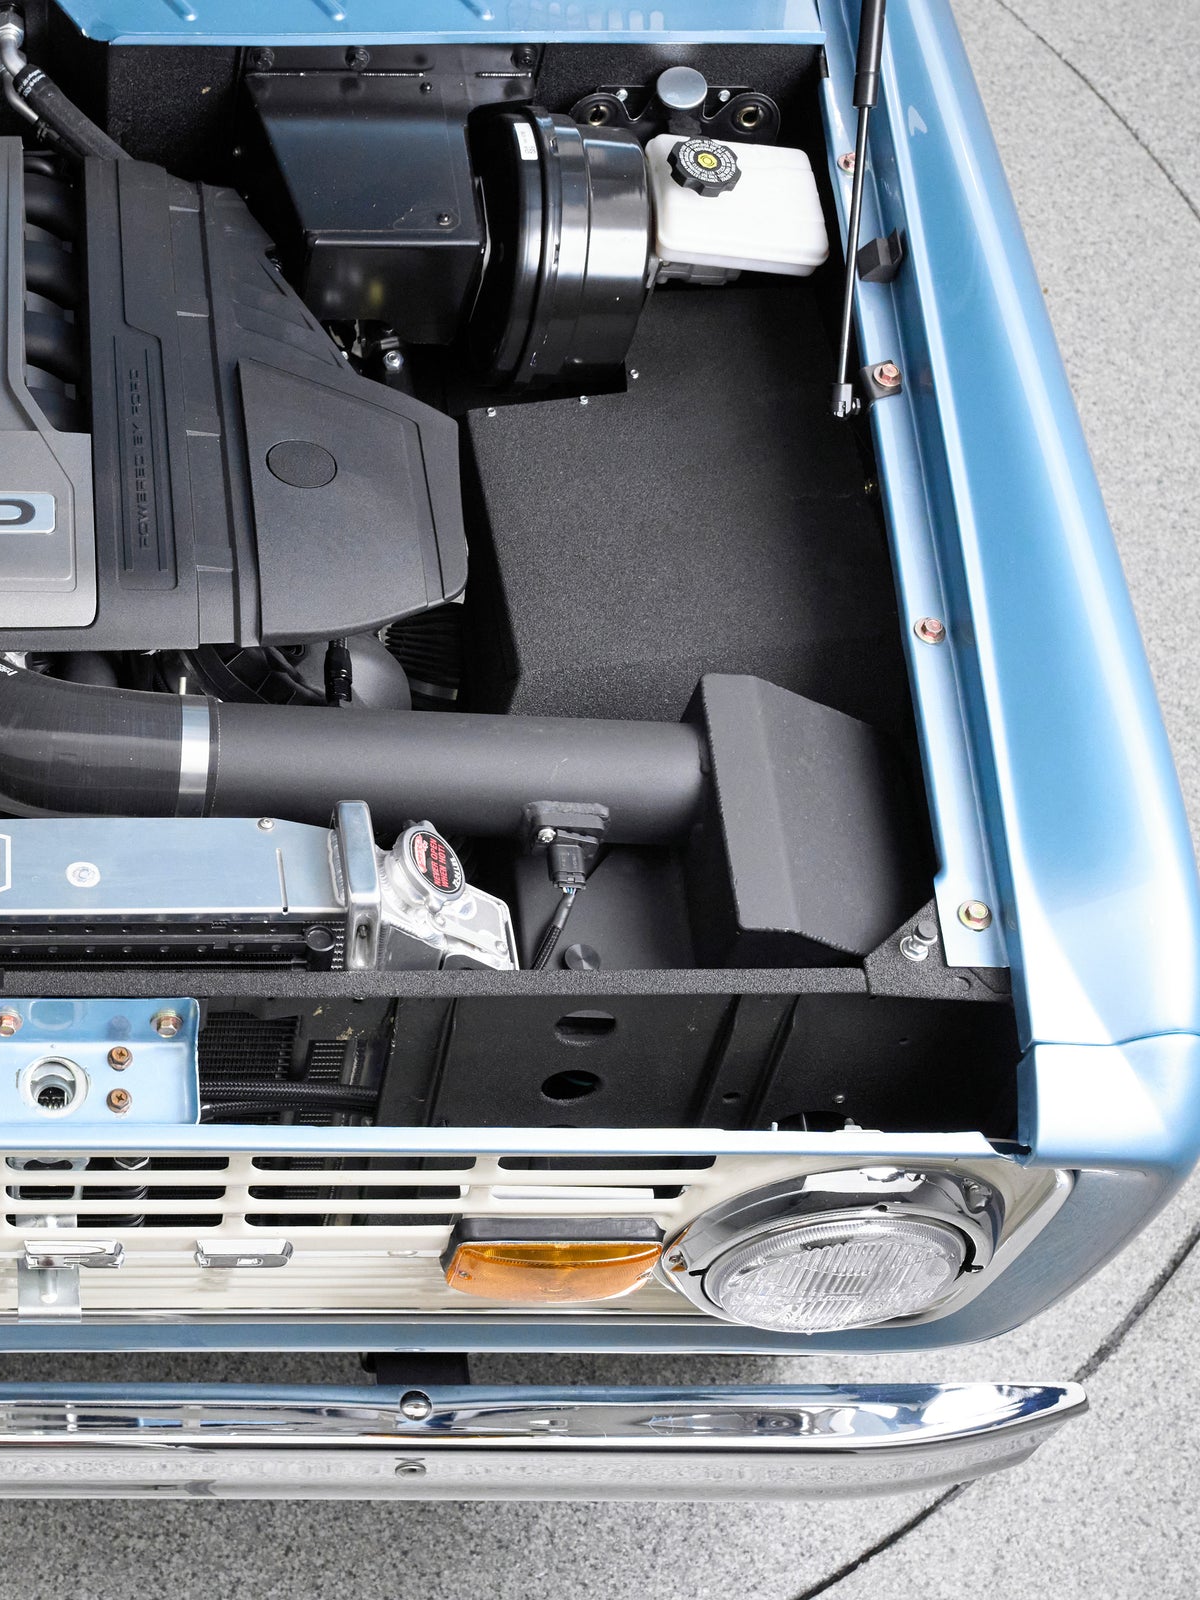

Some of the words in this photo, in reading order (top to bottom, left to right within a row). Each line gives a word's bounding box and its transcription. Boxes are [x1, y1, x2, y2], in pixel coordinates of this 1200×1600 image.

[132, 423, 144, 447] BY
[134, 455, 150, 549] POWERED
[430, 837, 439, 860] OPEN
[431, 861, 442, 887] NEVER
[439, 865, 449, 888] WHEN
